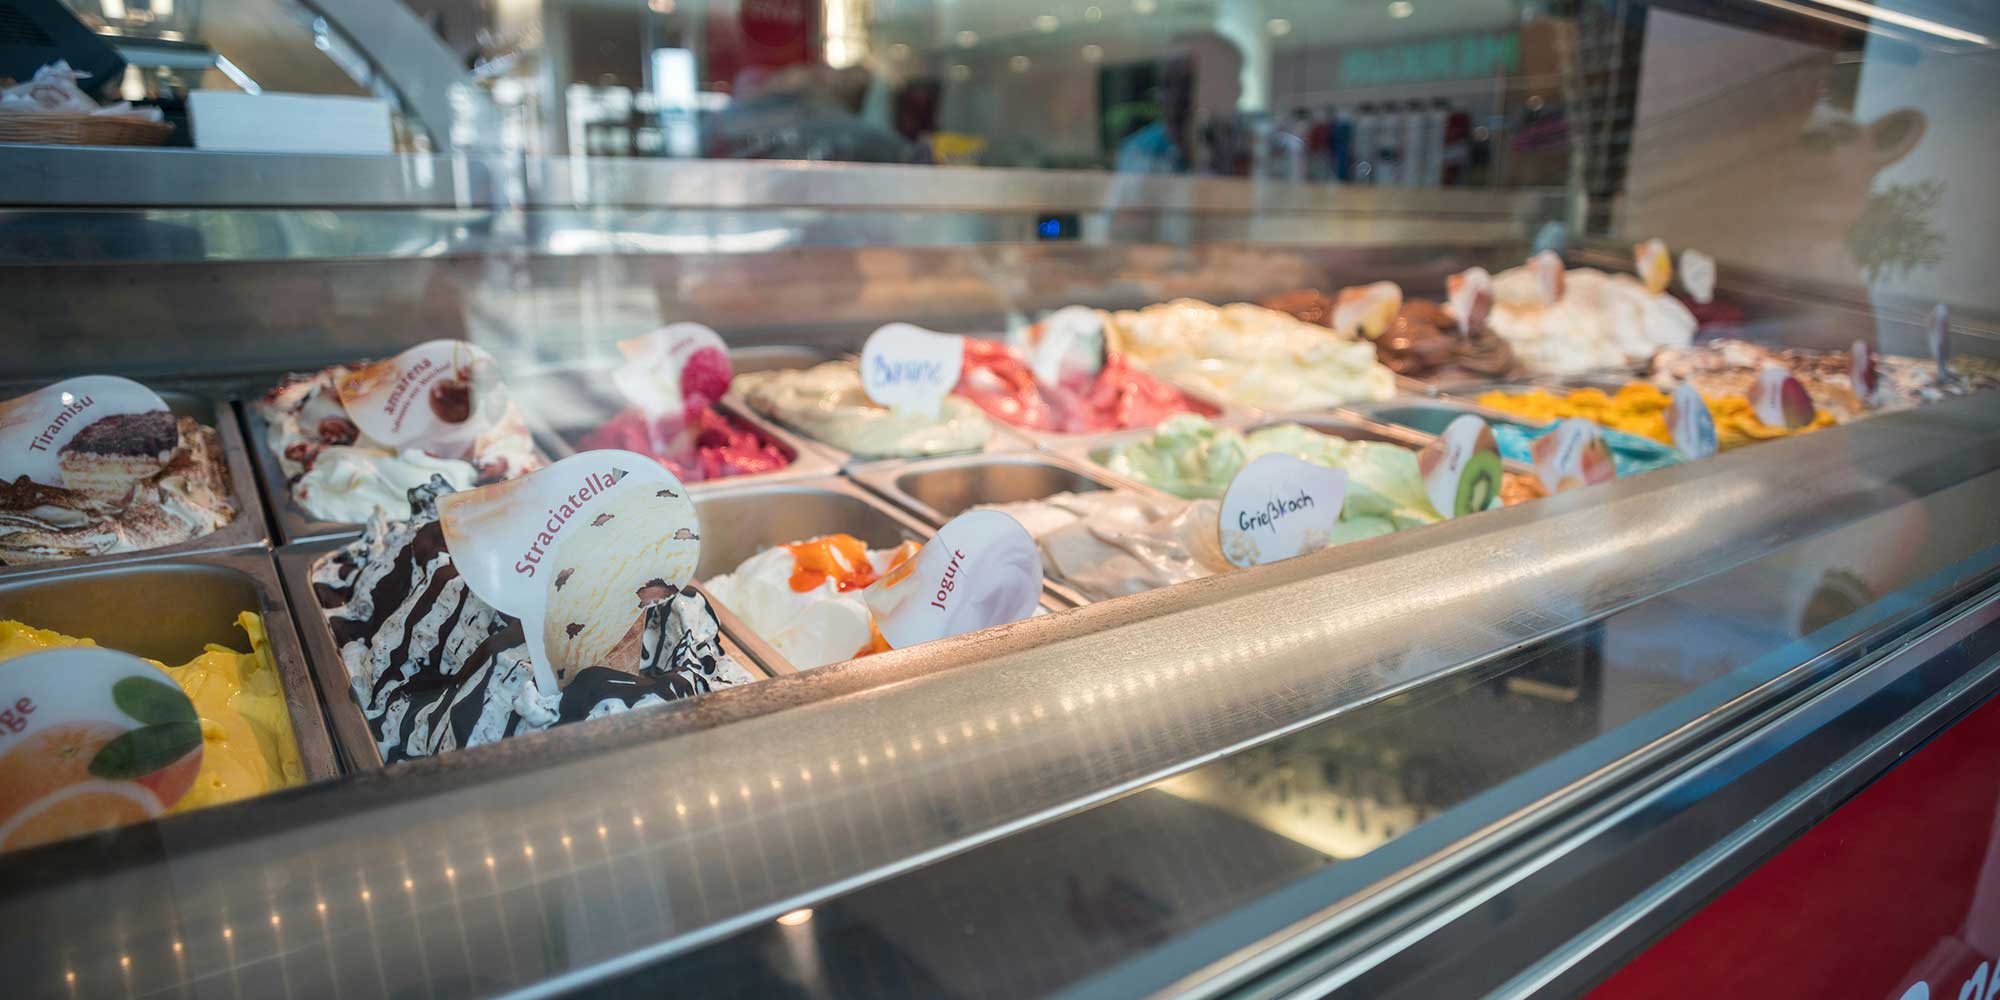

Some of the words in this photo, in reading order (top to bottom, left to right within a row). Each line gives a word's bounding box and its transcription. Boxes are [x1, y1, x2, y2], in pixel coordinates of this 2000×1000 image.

[384, 357, 432, 415] amarena
[30, 395, 95, 452] Tiramisu
[515, 472, 617, 578] Straciatella
[1239, 487, 1315, 535] Grießkoch
[930, 548, 966, 611] Jogurt
